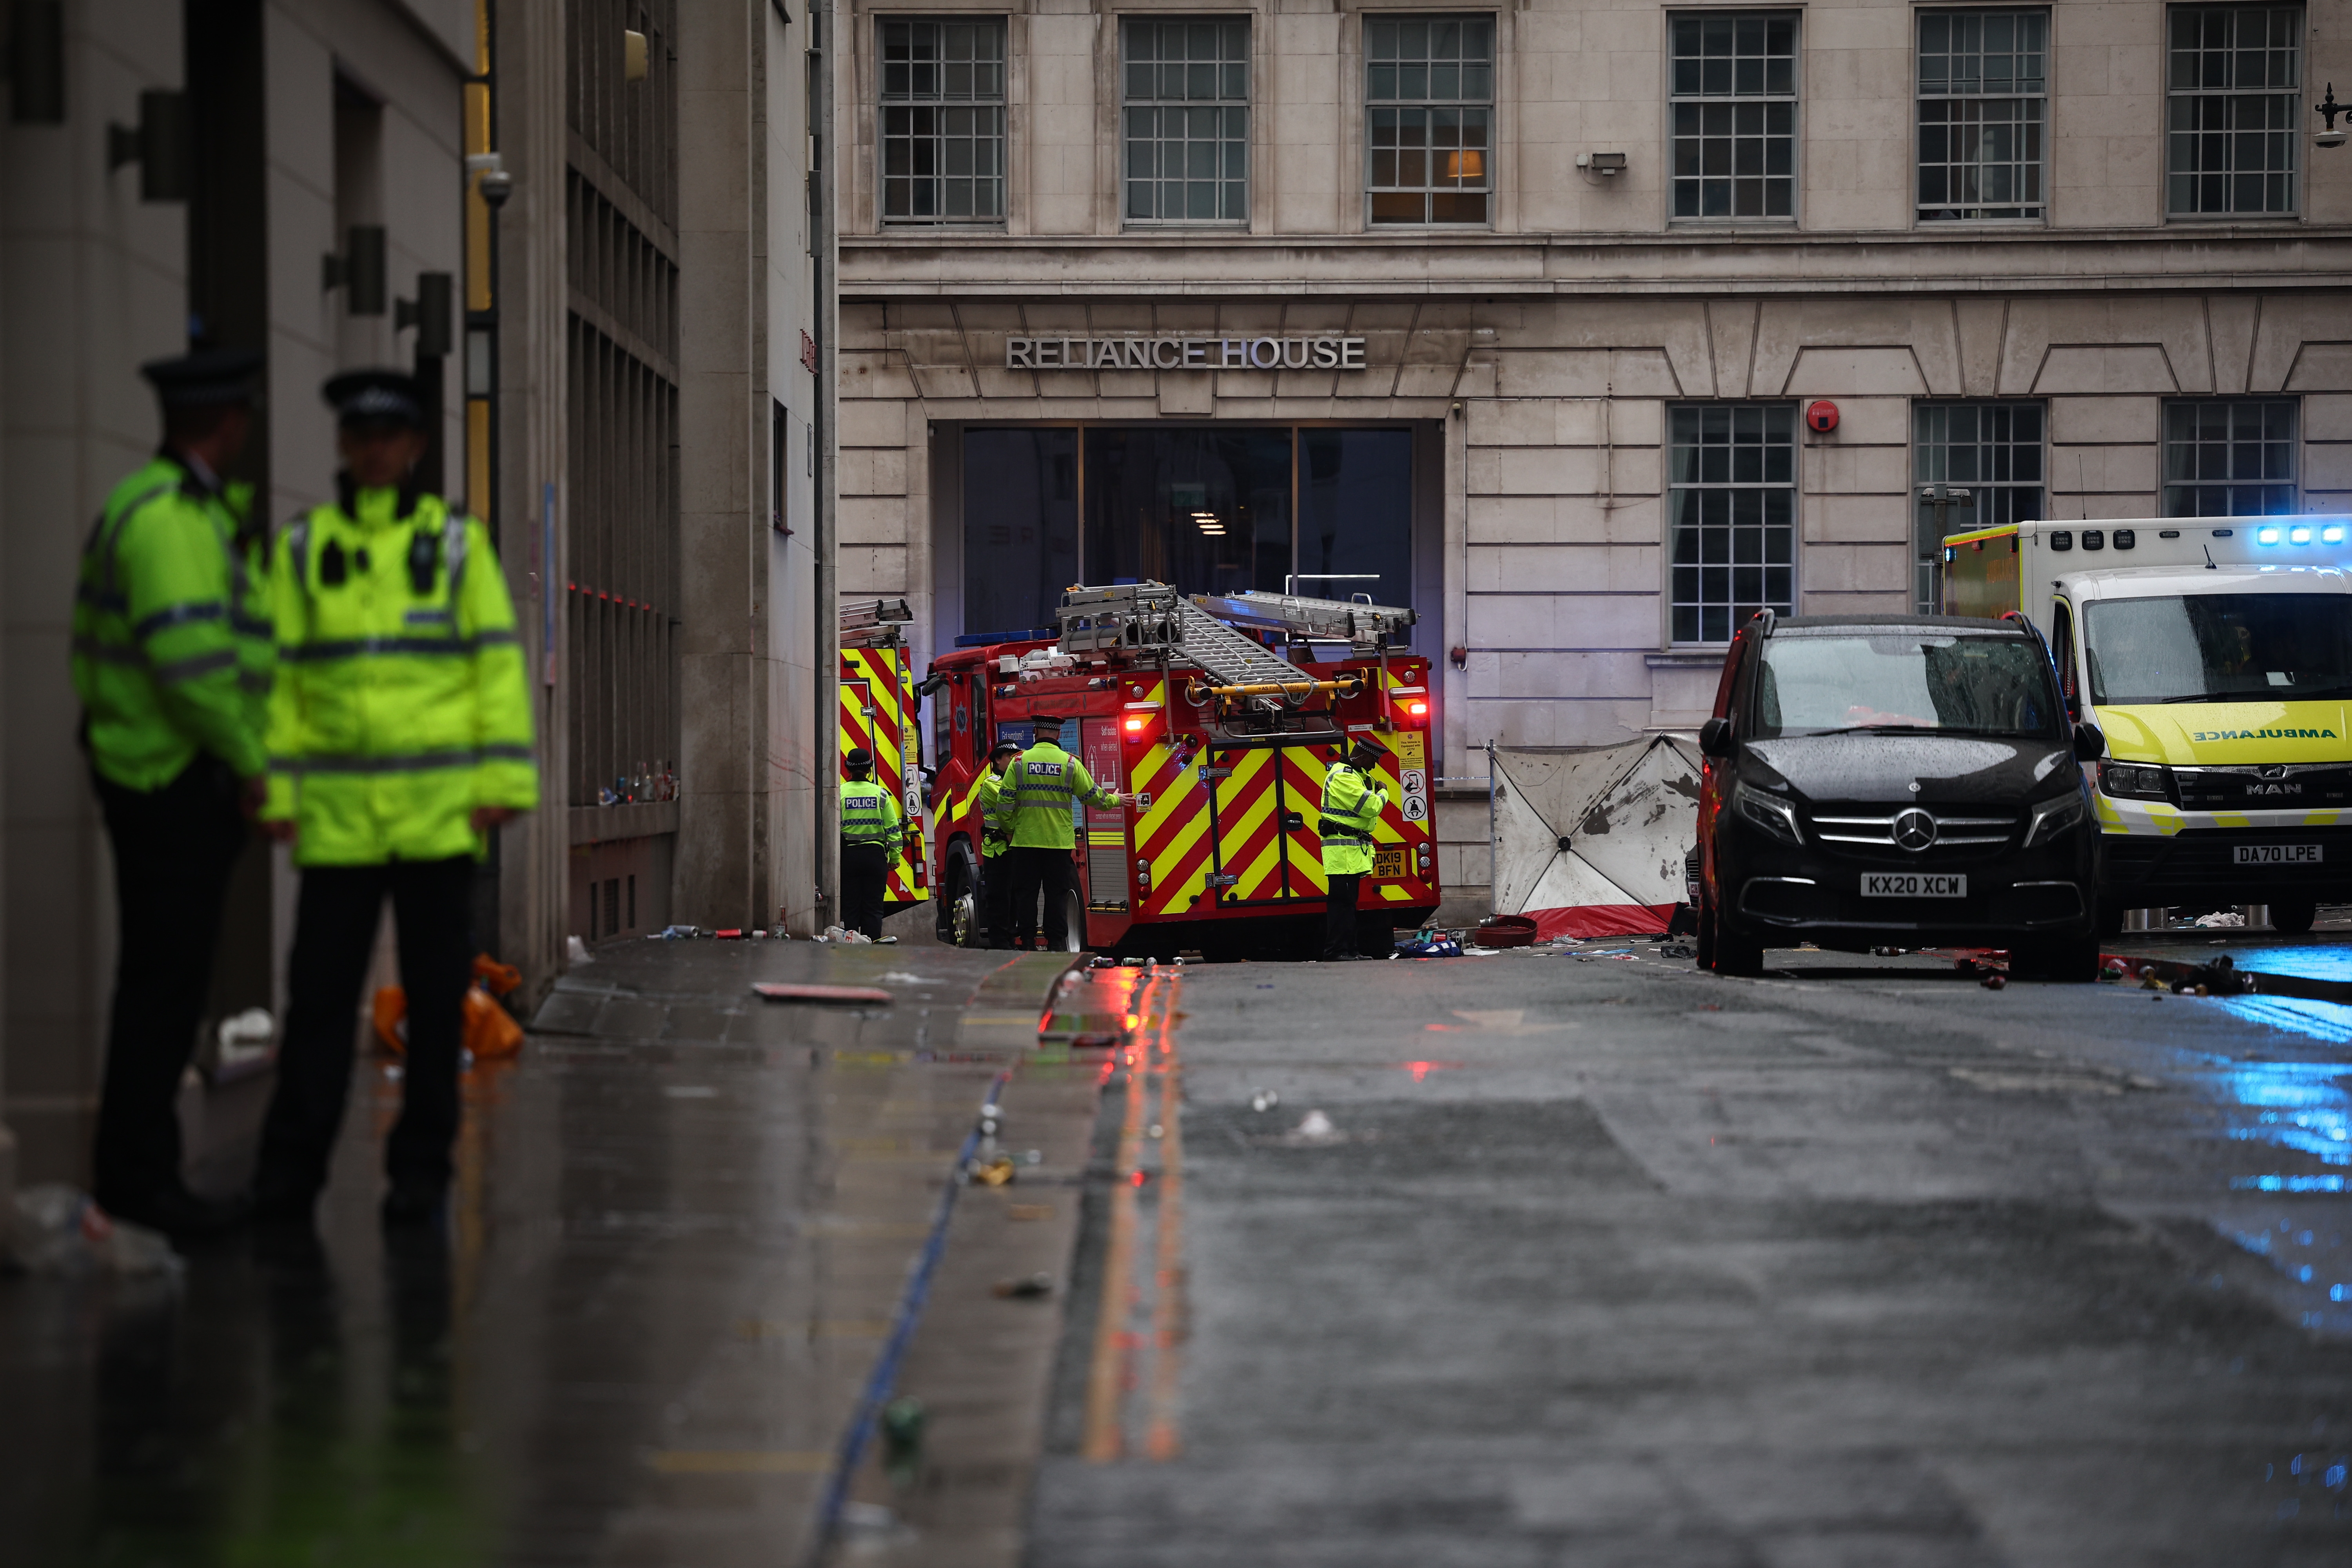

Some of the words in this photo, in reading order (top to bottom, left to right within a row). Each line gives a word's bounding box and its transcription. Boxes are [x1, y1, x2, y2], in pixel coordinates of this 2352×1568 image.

[1006, 337, 1207, 369] RELIANCE
[1222, 336, 1366, 369] HOUSE
[1107, 726, 1116, 735] isolate
[1029, 764, 1060, 775] POLICE
[2246, 784, 2301, 795] MAN
[846, 798, 876, 808] POLICE
[1376, 852, 1401, 864] DK19
[2239, 847, 2281, 862] DA70
[2285, 846, 2316, 861] LPE
[1378, 864, 1400, 877] BFN
[1869, 876, 1918, 894] KX20
[1923, 877, 1958, 894] XCW
